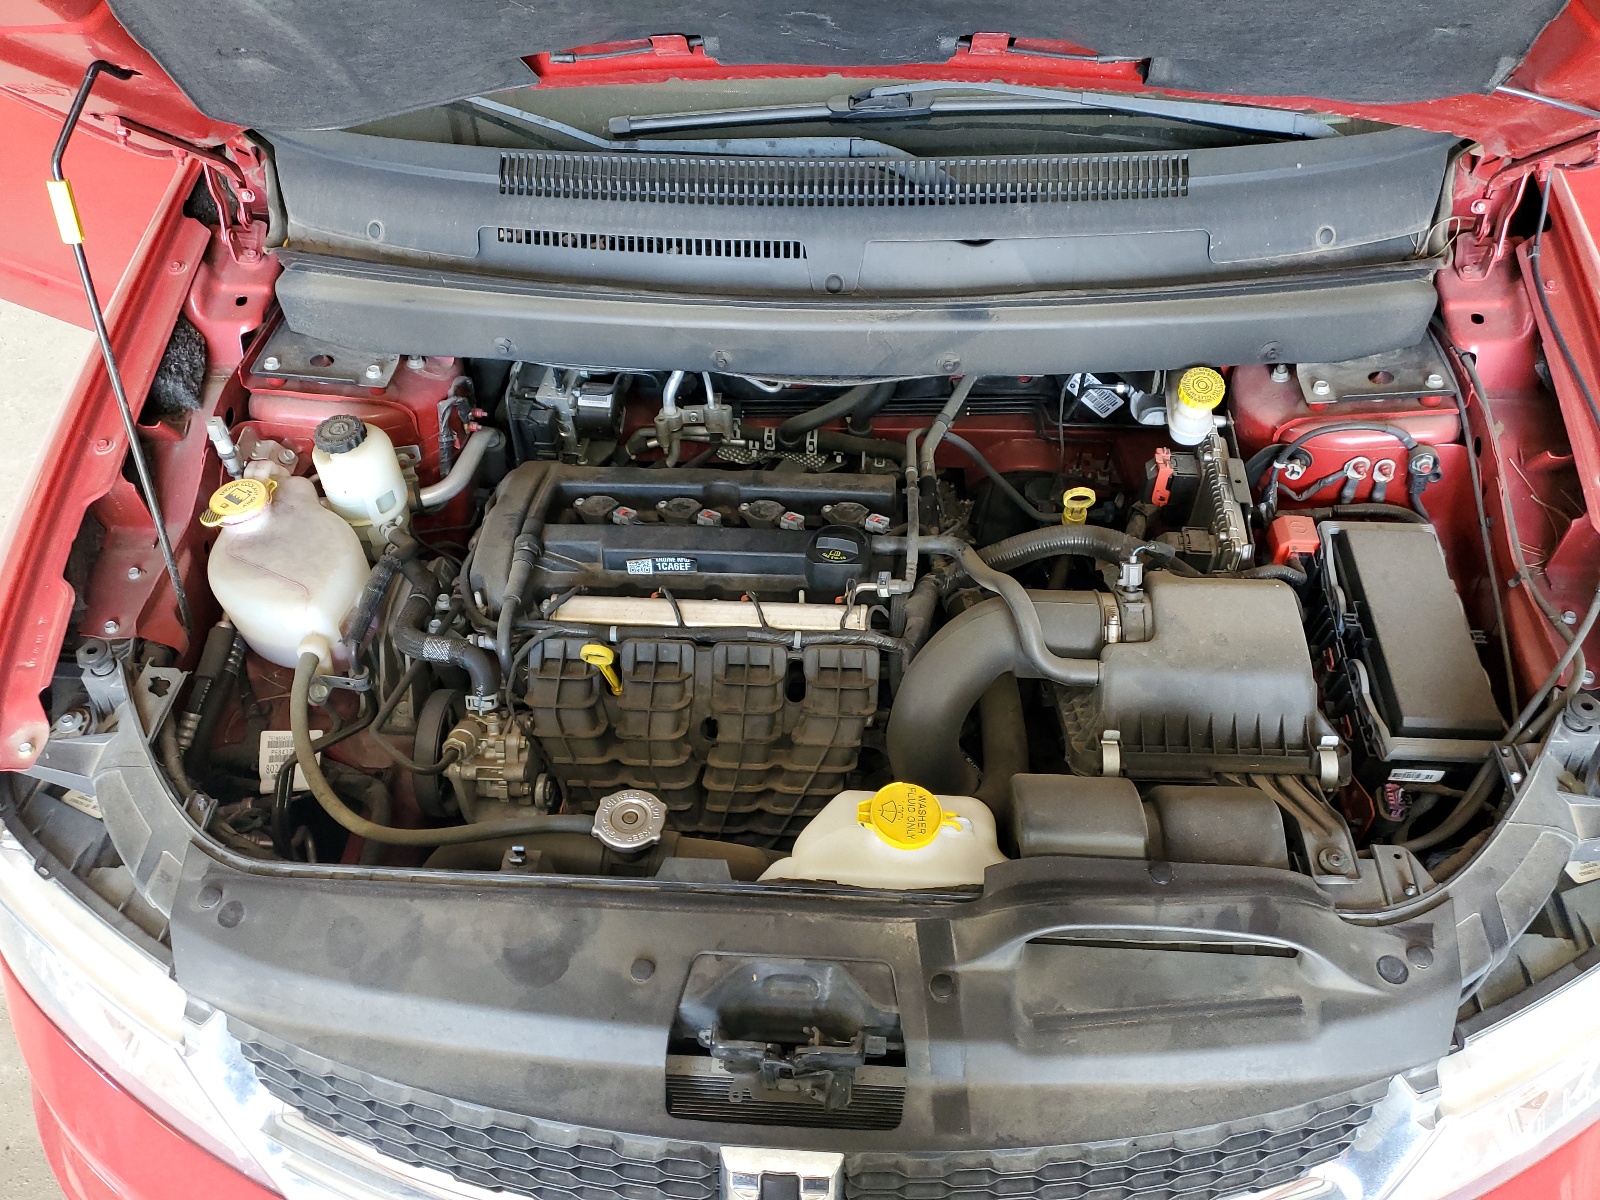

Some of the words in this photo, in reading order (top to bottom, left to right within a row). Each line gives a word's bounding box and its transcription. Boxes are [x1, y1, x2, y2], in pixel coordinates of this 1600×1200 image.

[656, 562, 691, 571] 1CA6EF
[907, 787, 917, 813] FLUID
[917, 794, 927, 835] WASHER
[906, 815, 916, 840] ONLY
